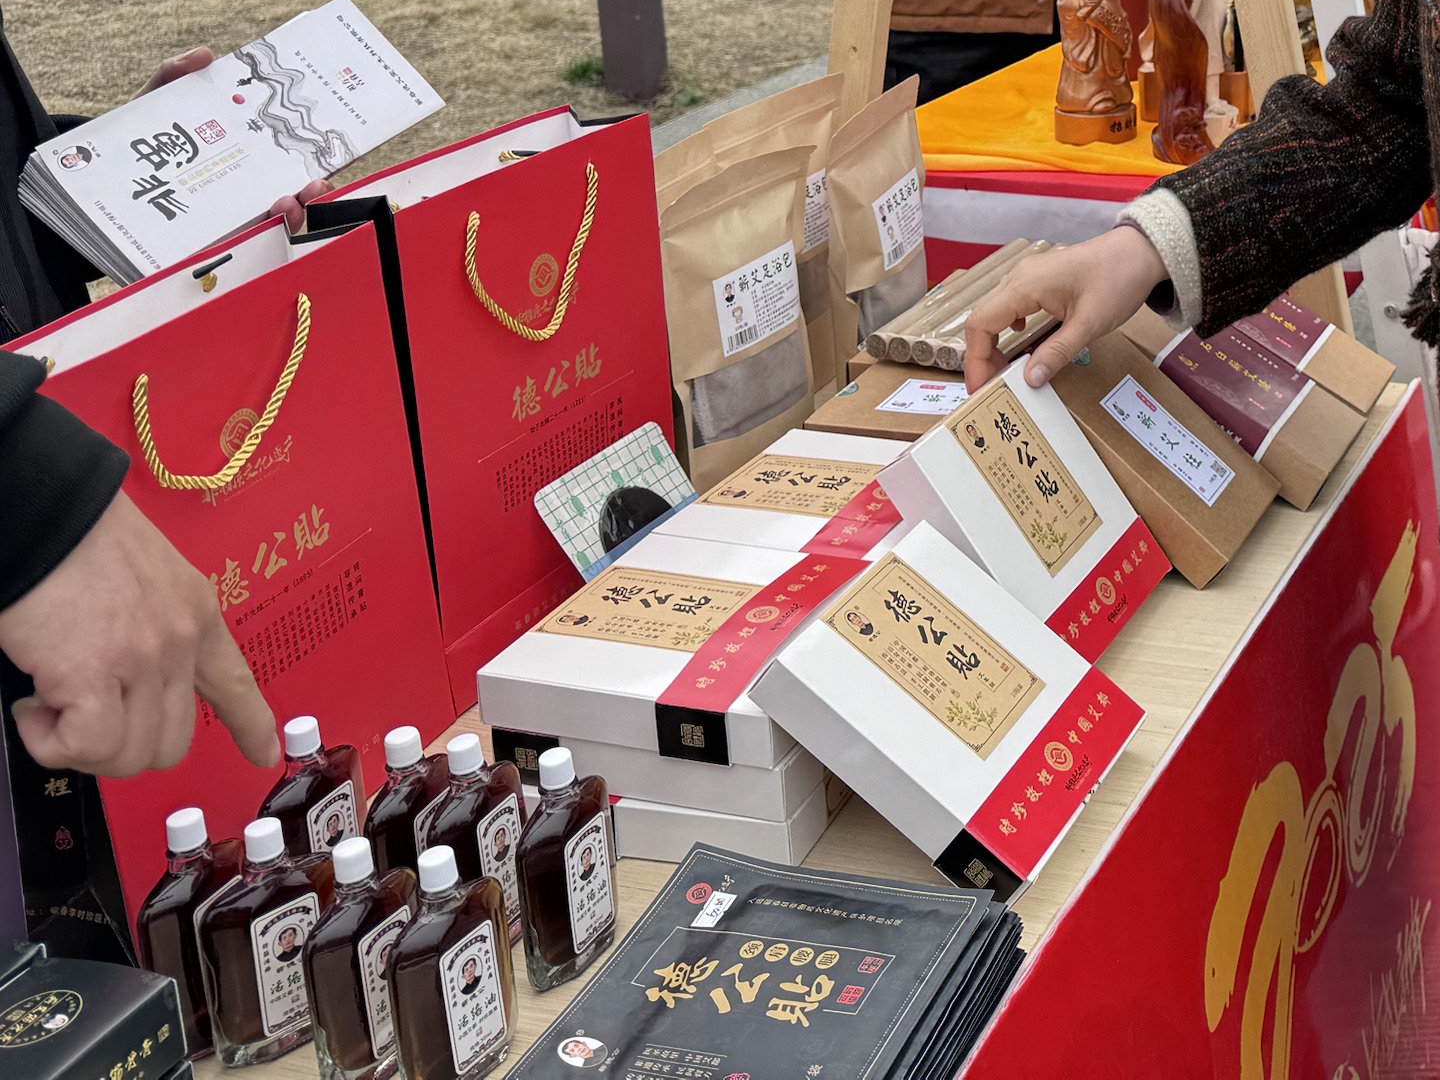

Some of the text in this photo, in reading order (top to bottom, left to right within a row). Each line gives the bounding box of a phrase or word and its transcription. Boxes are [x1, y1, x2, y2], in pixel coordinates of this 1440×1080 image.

[738, 252, 793, 293] 蕲艾足浴包
[601, 585, 713, 617] 德公貼
[883, 589, 981, 681] 德公貼
[457, 992, 497, 1031] 活络油
[645, 956, 835, 1027] 德公貼
